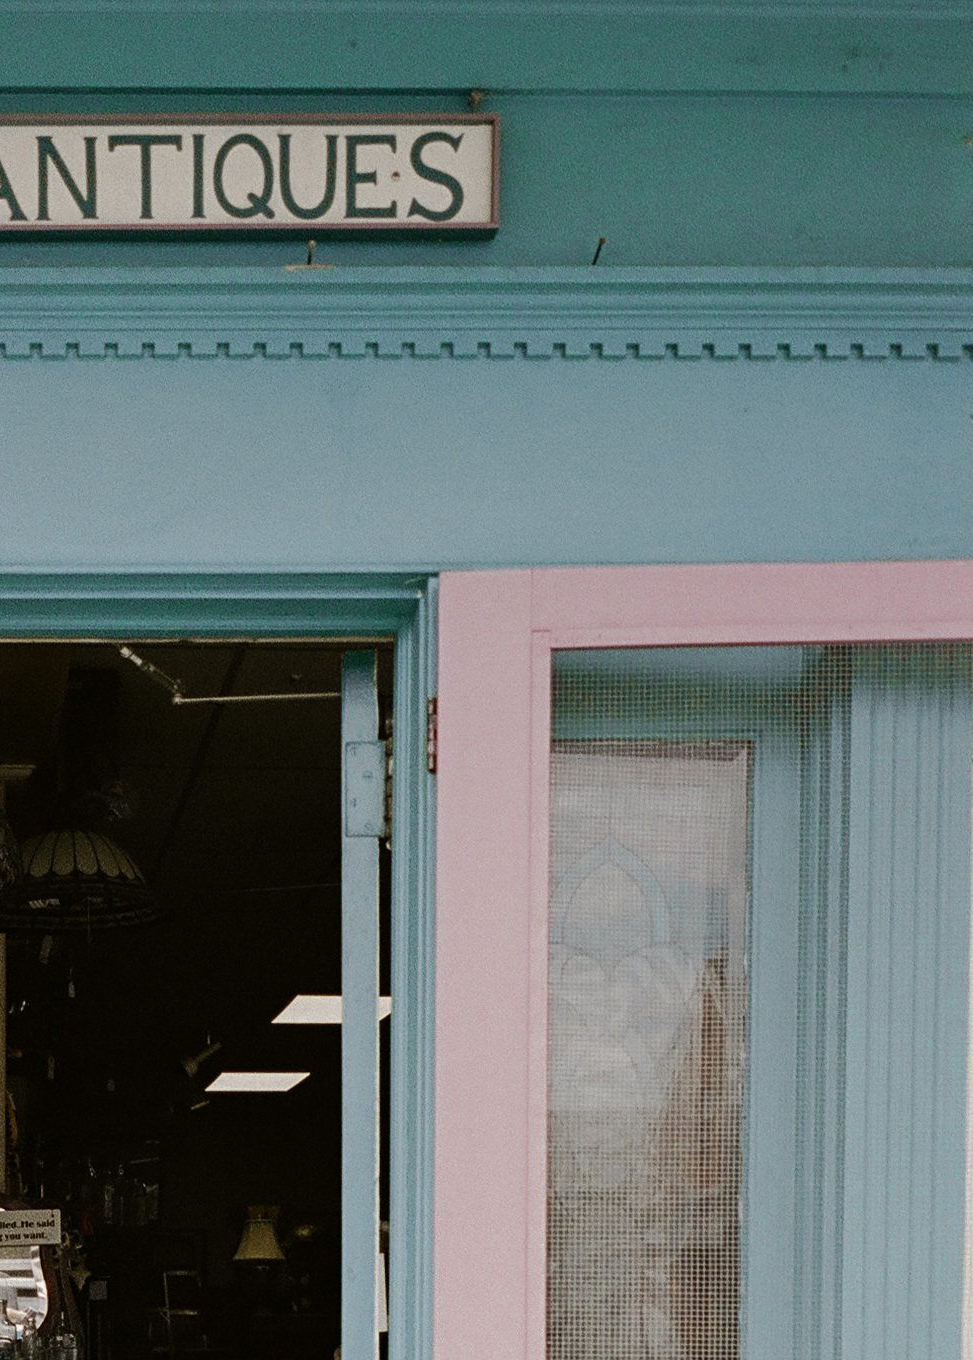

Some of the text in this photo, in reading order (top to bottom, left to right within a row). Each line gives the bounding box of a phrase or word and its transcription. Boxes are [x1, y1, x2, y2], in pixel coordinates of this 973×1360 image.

[37, 1219, 55, 1227] said
[3, 1233, 21, 1241] you
[23, 1232, 48, 1240] want.
